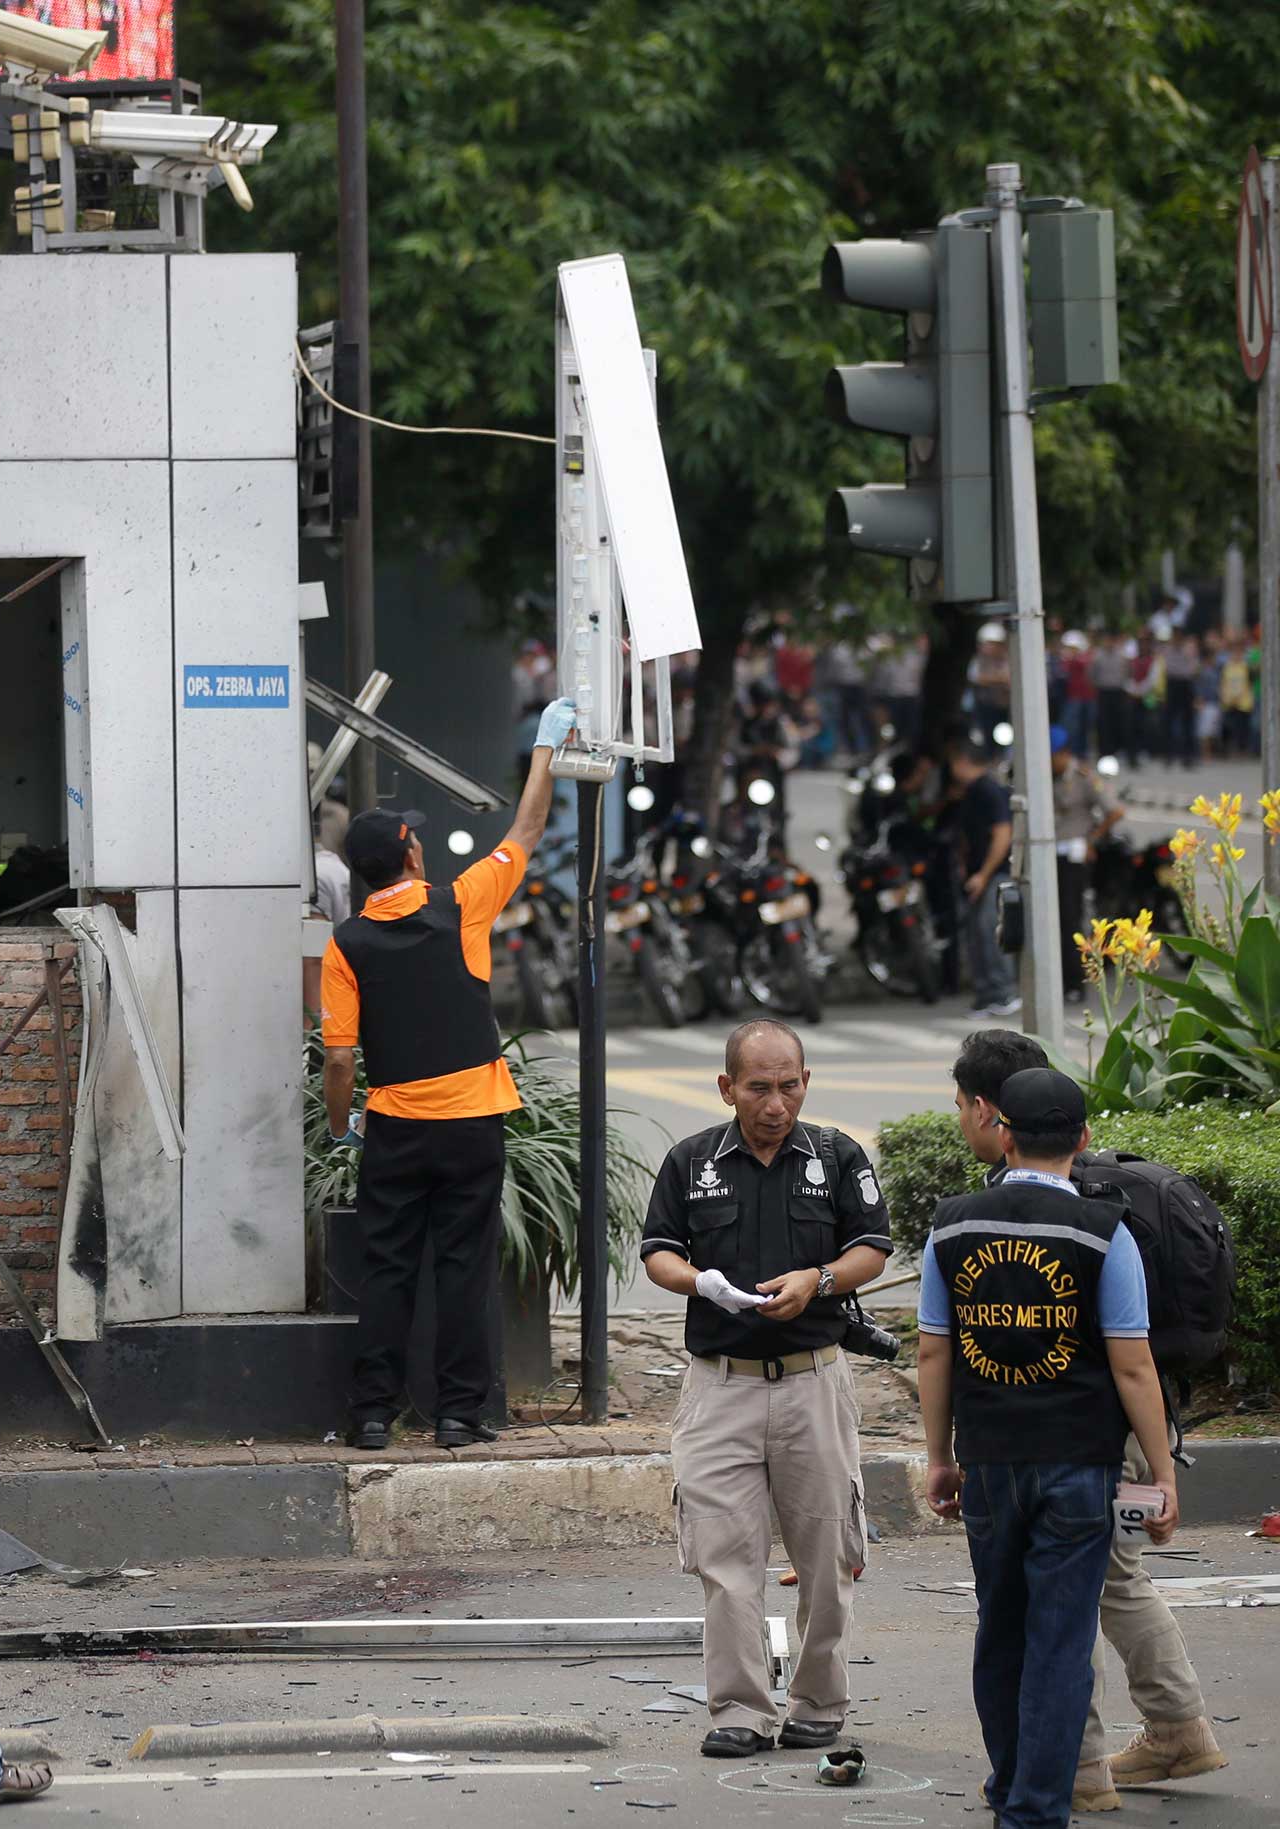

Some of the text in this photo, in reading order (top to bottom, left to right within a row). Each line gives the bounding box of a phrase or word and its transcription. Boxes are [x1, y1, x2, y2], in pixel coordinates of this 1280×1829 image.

[186, 676, 286, 697] OPS. ZEBRA JAYA
[801, 1186, 830, 1198] IDENT
[954, 1240, 1079, 1298] IDENTIFIKASI
[956, 1304, 1078, 1329] POLRES METRO
[959, 1329, 1080, 1386] JAKARTA PUSAT
[1120, 1508, 1145, 1536] 16
